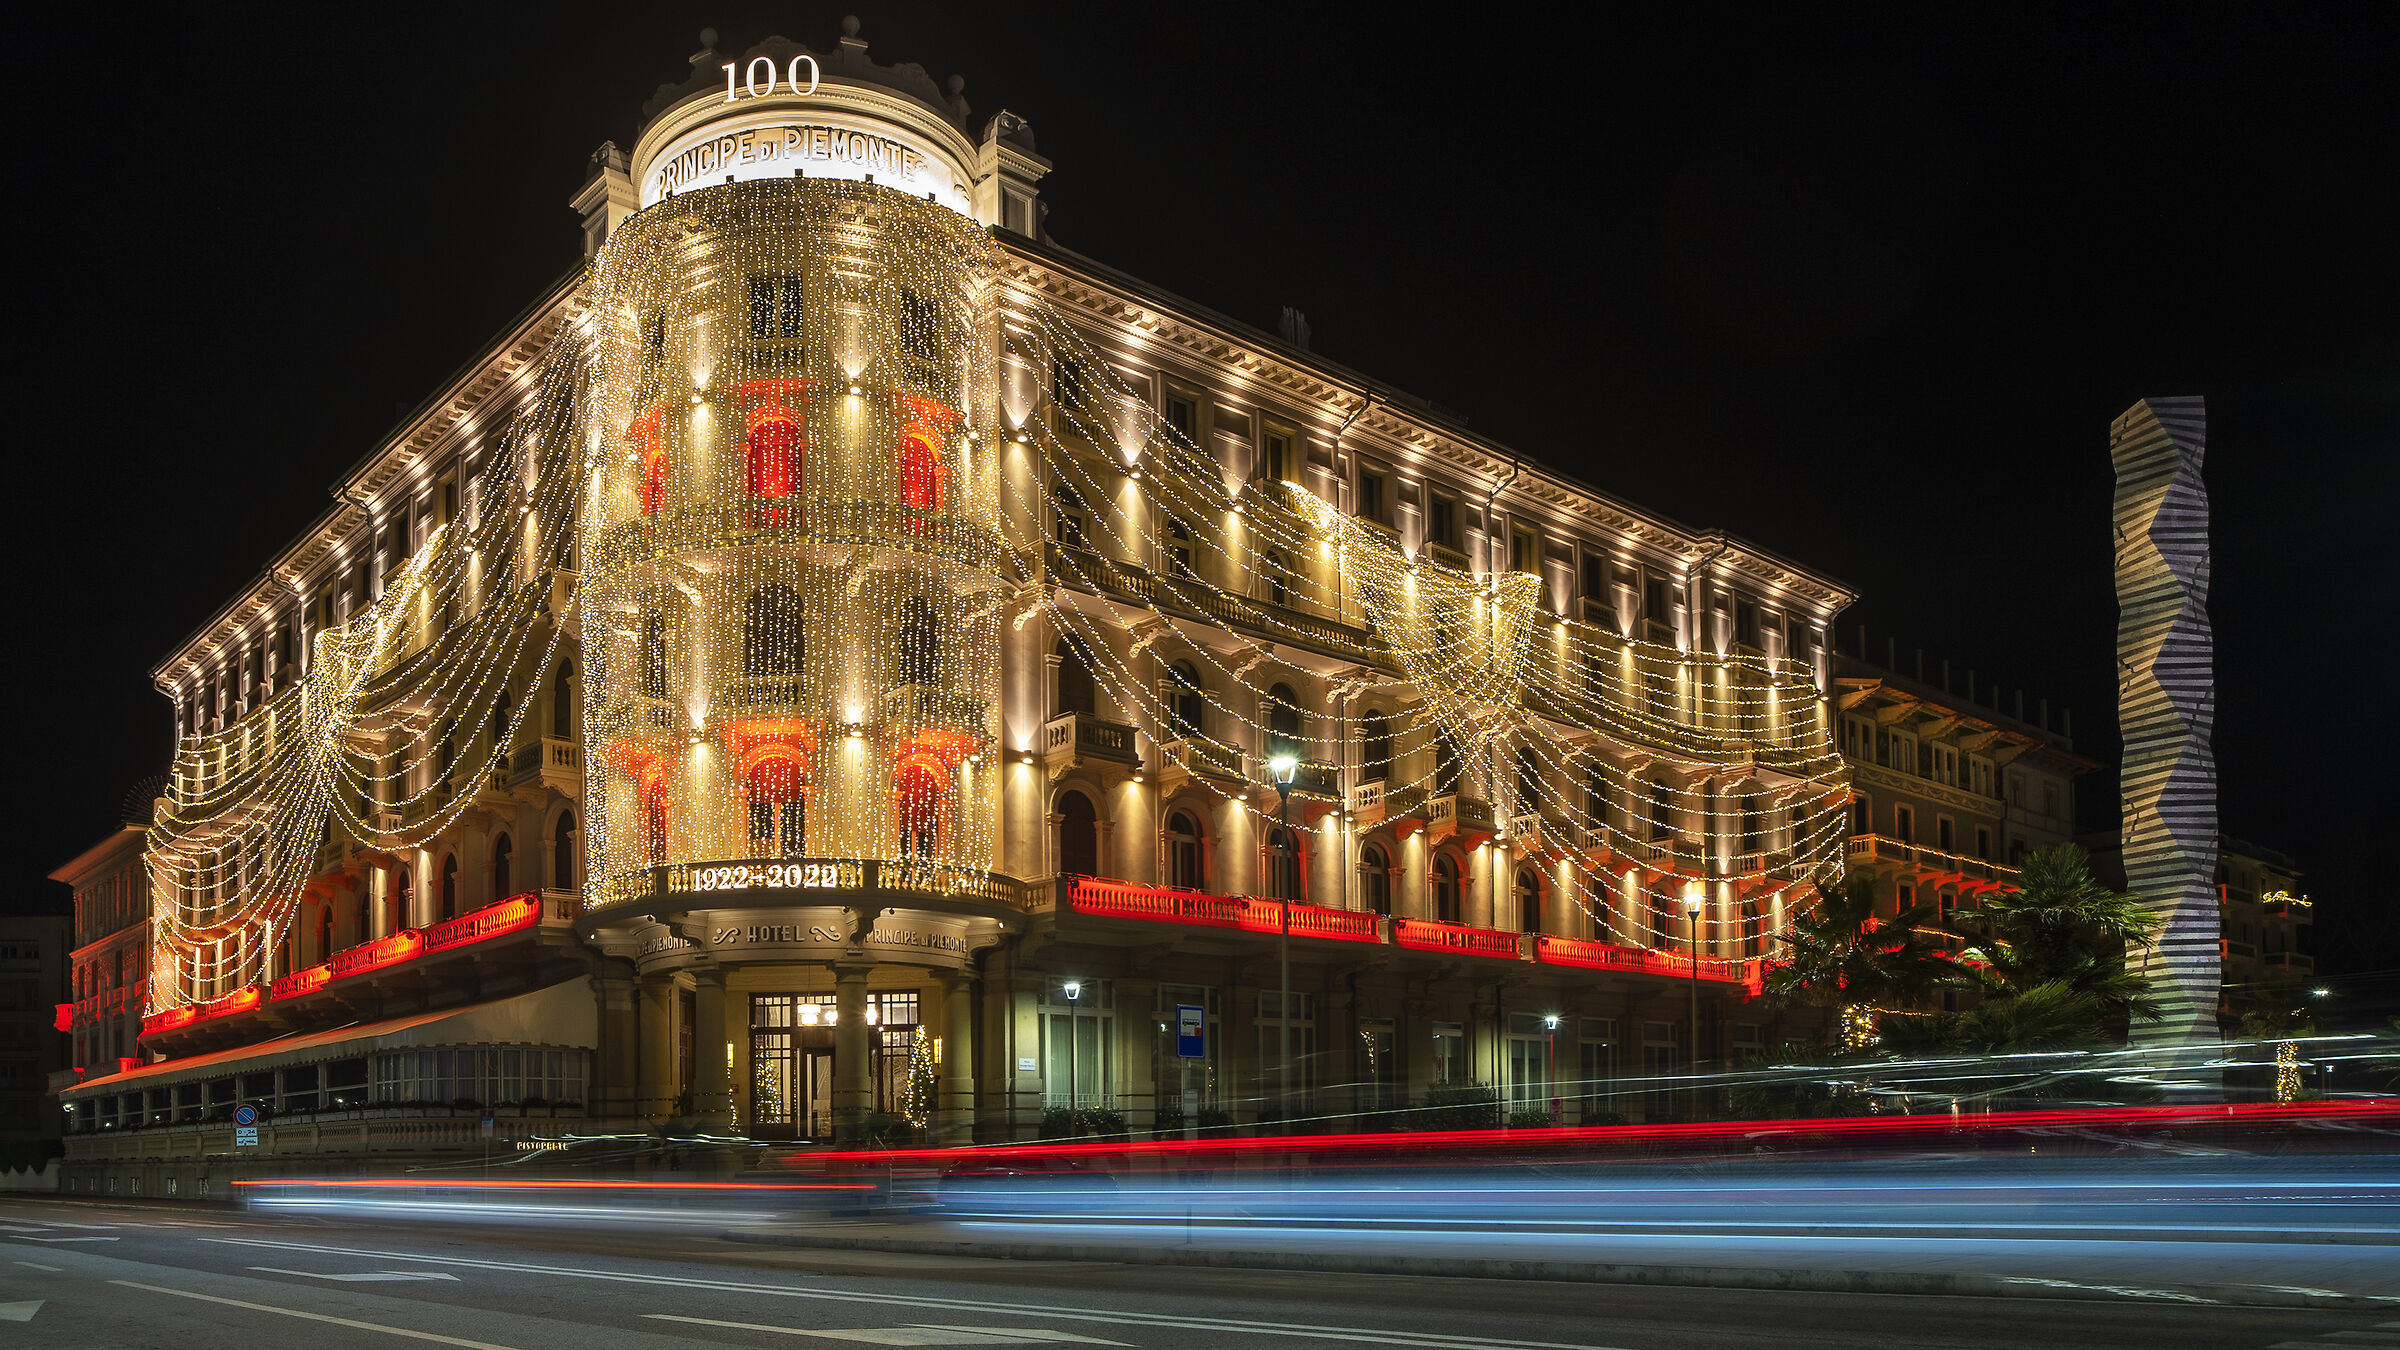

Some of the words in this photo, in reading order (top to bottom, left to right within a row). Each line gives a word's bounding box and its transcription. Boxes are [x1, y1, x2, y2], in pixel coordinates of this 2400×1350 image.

[721, 55, 820, 103] 100
[658, 131, 757, 200] PRINCIPE
[783, 126, 919, 182] PIEMONTE
[746, 925, 806, 942] HOTEL
[866, 929, 918, 946] PRINCIPE
[931, 934, 967, 953] PIEMONTE
